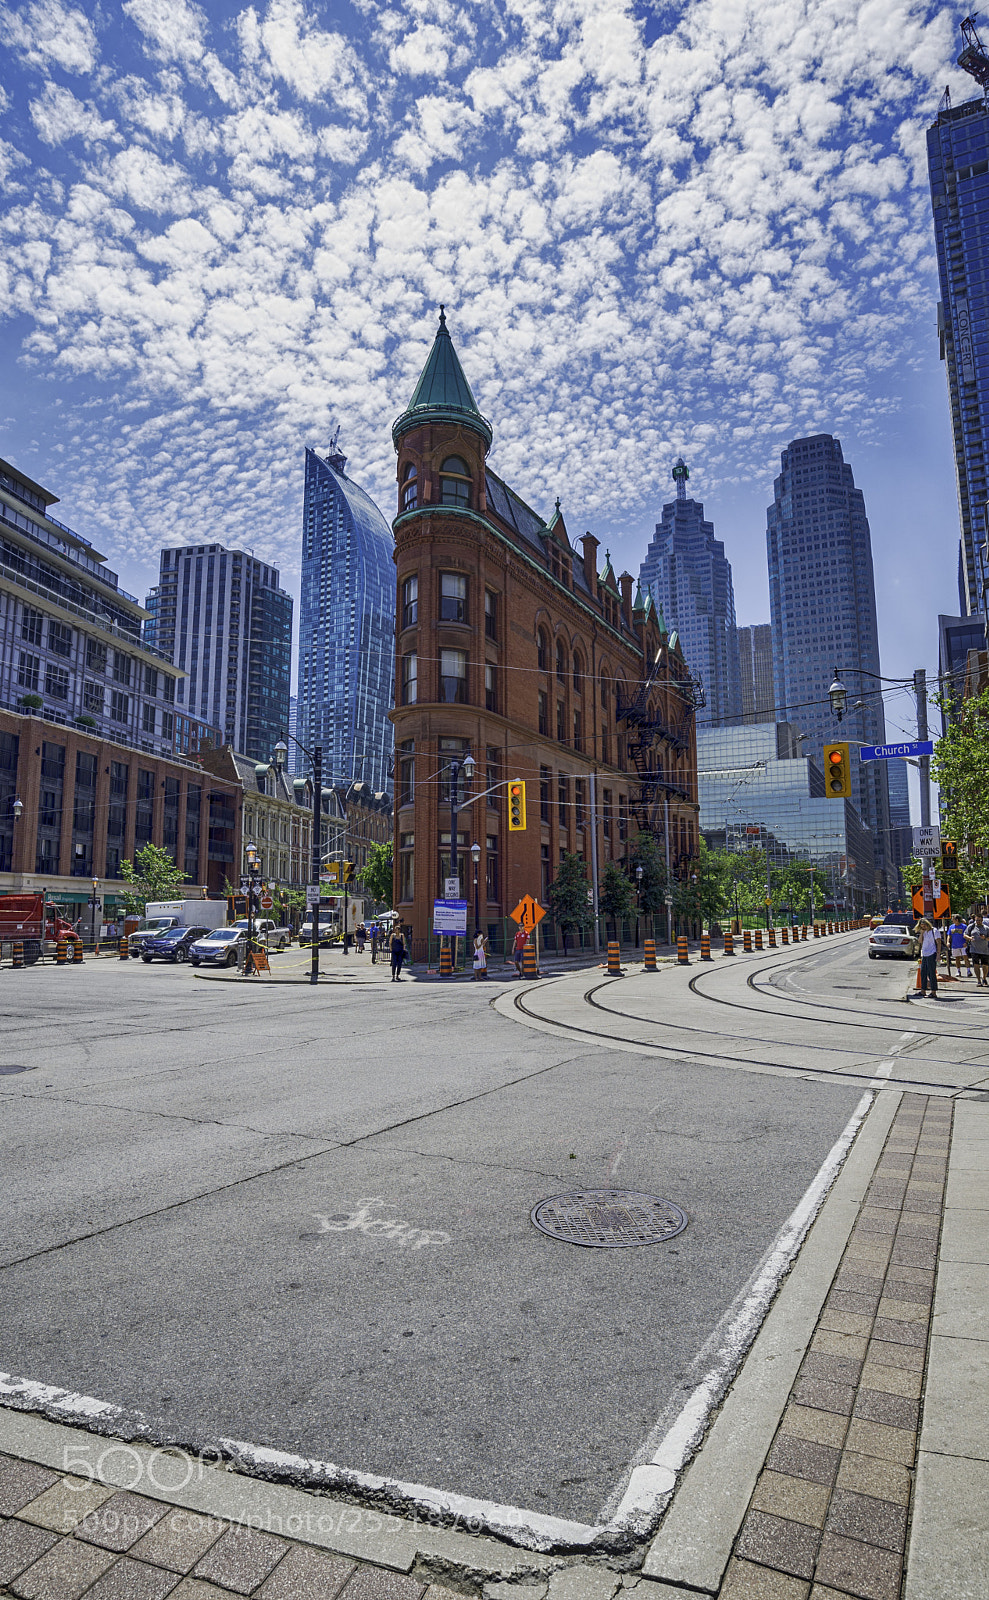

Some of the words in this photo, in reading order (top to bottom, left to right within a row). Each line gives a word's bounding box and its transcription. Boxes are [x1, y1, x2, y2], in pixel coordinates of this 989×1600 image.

[958, 309, 972, 367] CONCERT
[874, 744, 910, 757] Church
[919, 828, 933, 836] ONE
[919, 838, 934, 846] WAY
[915, 847, 940, 856] BEGINS
